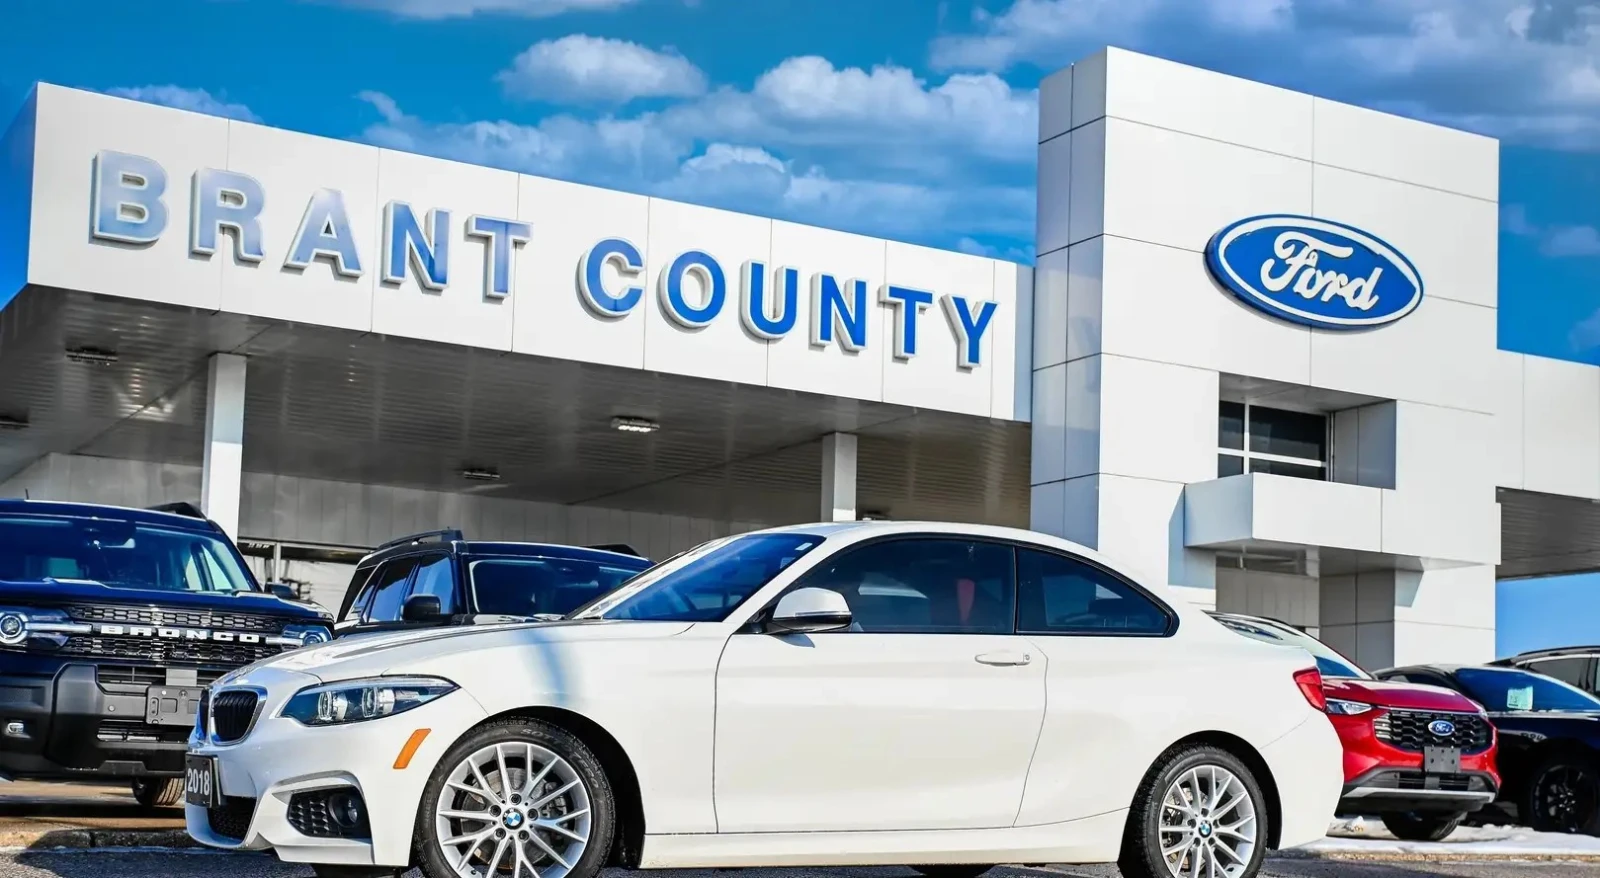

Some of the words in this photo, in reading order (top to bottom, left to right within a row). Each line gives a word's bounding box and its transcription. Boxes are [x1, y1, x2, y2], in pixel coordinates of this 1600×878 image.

[92, 149, 534, 299] BRANT
[579, 237, 1000, 369] COUNTY
[1260, 231, 1383, 311] Ford
[100, 625, 260, 643] BRONCO
[187, 767, 210, 796] 2018
